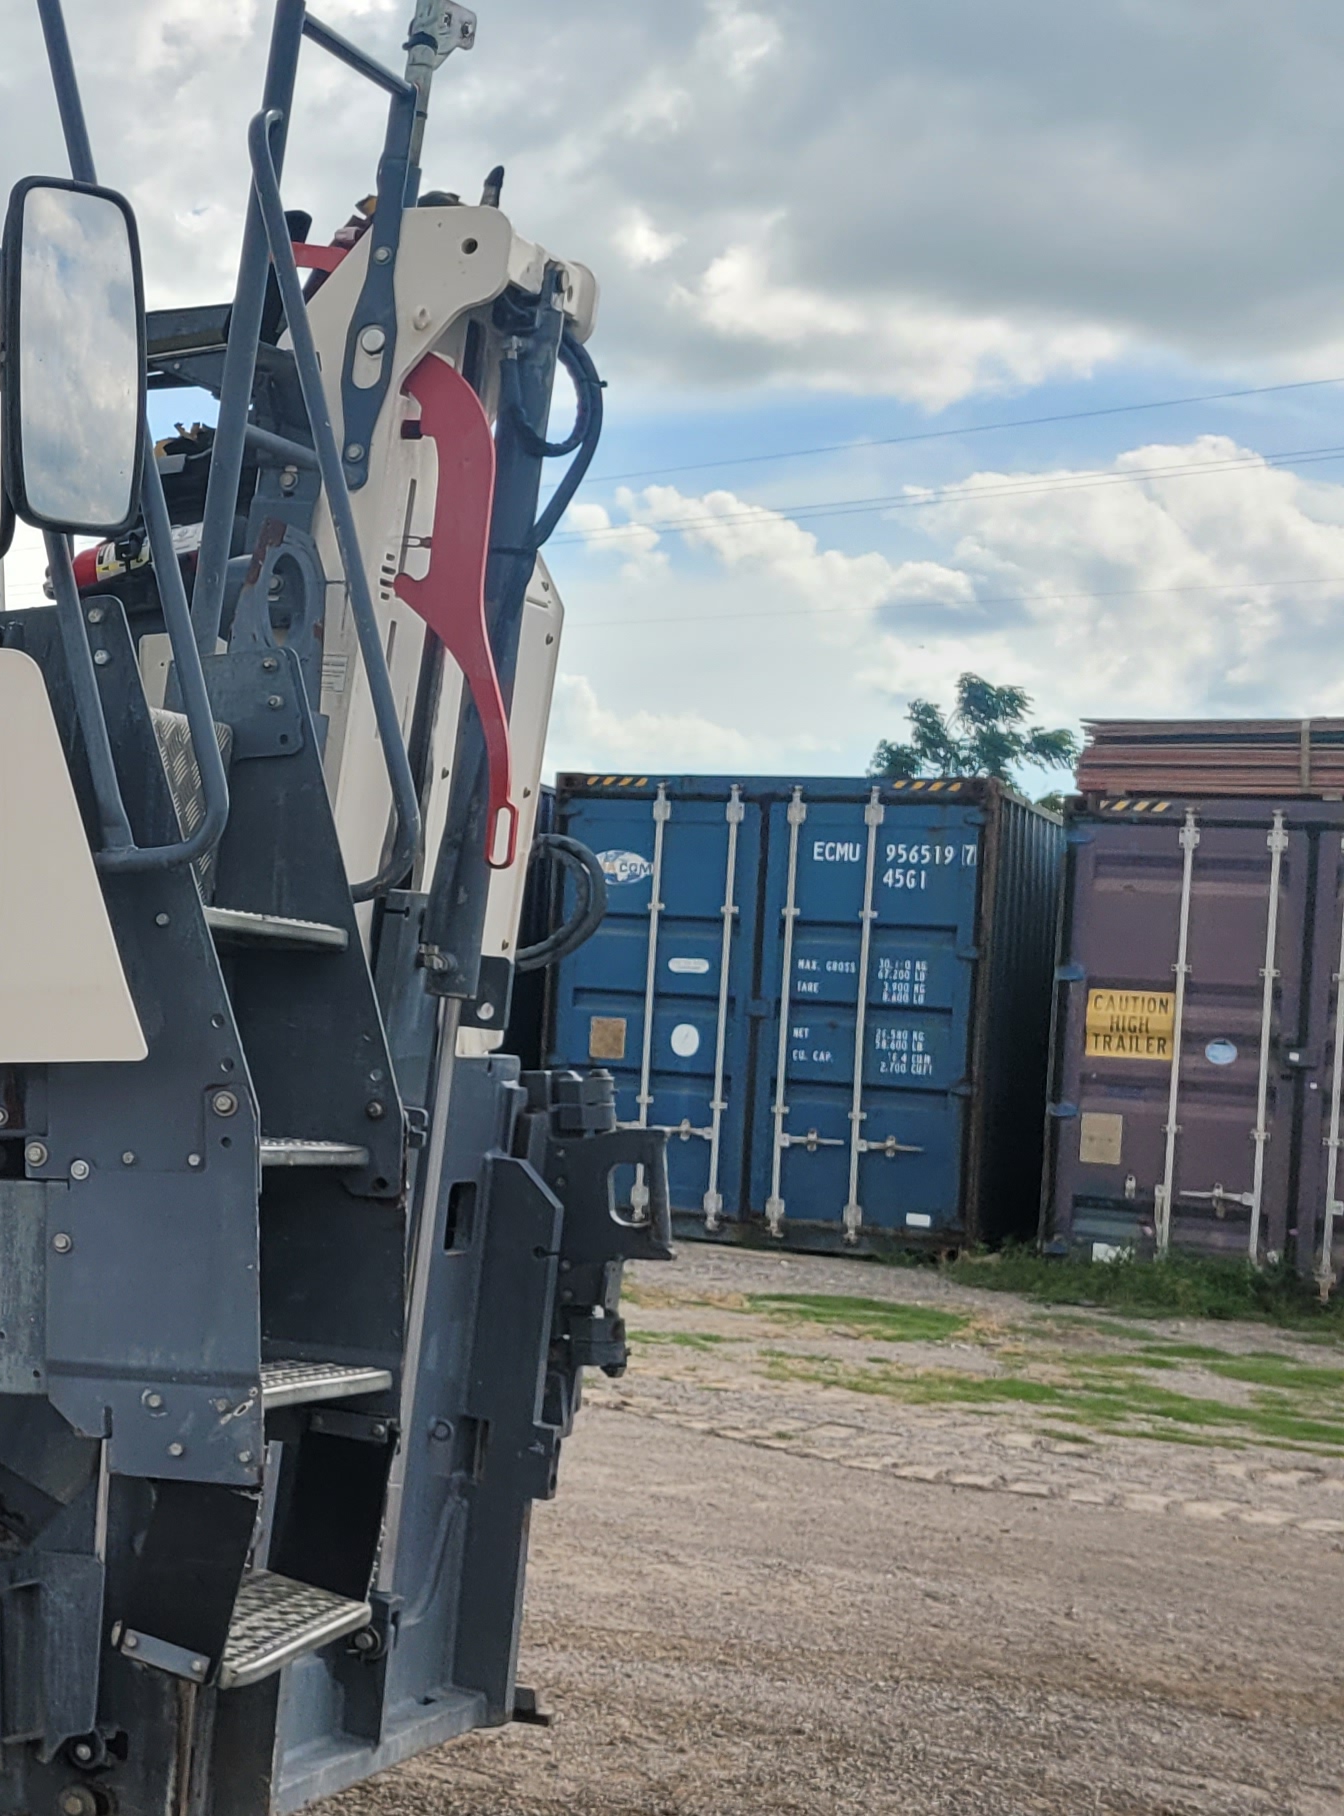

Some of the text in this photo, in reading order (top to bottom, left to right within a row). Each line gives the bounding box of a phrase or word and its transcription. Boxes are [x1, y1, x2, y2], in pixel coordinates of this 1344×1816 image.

[813, 841, 861, 862] ECMU
[886, 844, 954, 865] 956519
[826, 961, 855, 974] GROSS
[1094, 994, 1169, 1014] CAUTION
[1110, 1014, 1150, 1034] HIGH
[1093, 1032, 1167, 1055] TRAILER
